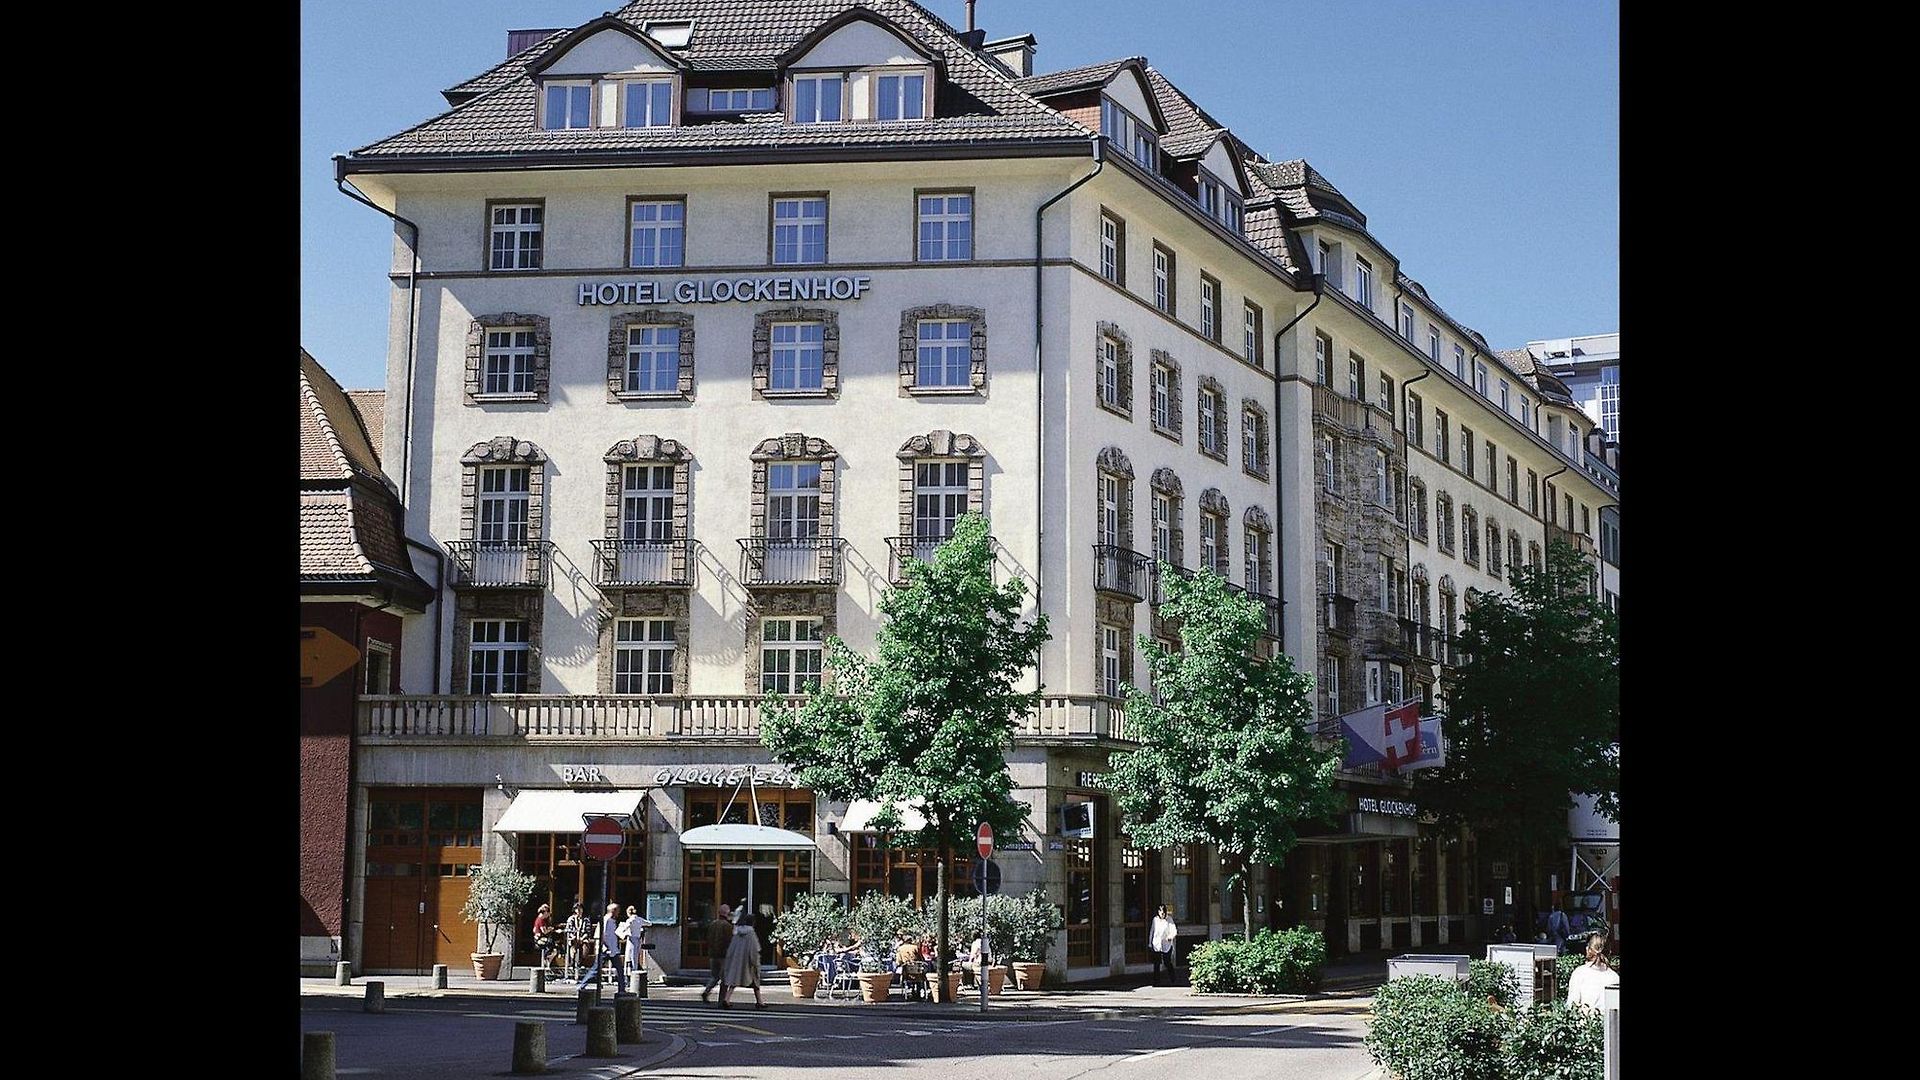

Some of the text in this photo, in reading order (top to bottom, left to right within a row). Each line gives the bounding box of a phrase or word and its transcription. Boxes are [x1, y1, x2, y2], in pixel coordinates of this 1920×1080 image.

[577, 276, 870, 305] HOTEL GLOCKENHOF
[562, 766, 602, 783] BAR
[1358, 797, 1417, 816] HOTEL GLOCKENHOF
